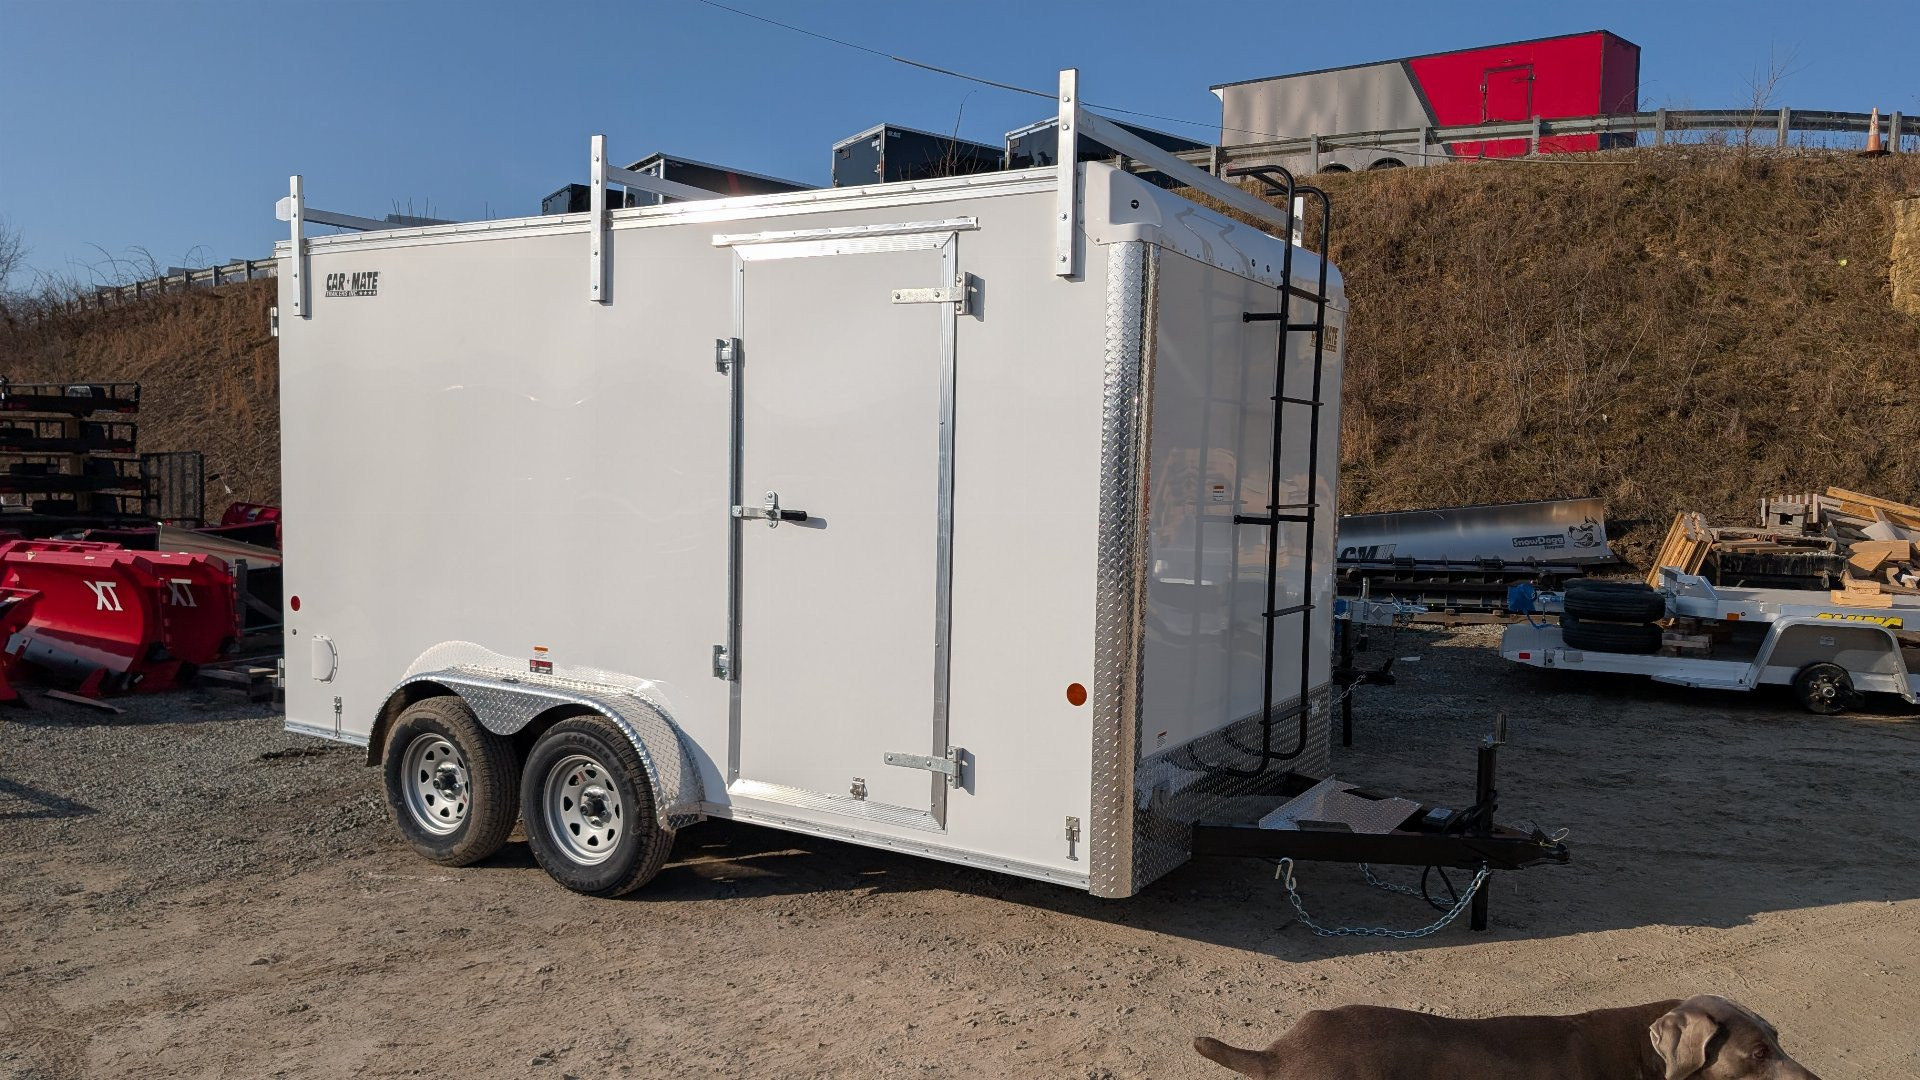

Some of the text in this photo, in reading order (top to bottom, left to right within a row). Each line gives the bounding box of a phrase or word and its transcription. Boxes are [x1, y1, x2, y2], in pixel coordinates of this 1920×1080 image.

[326, 271, 379, 291] CAR MATE
[1513, 535, 1565, 547] SnowDogg
[83, 580, 123, 611] XT
